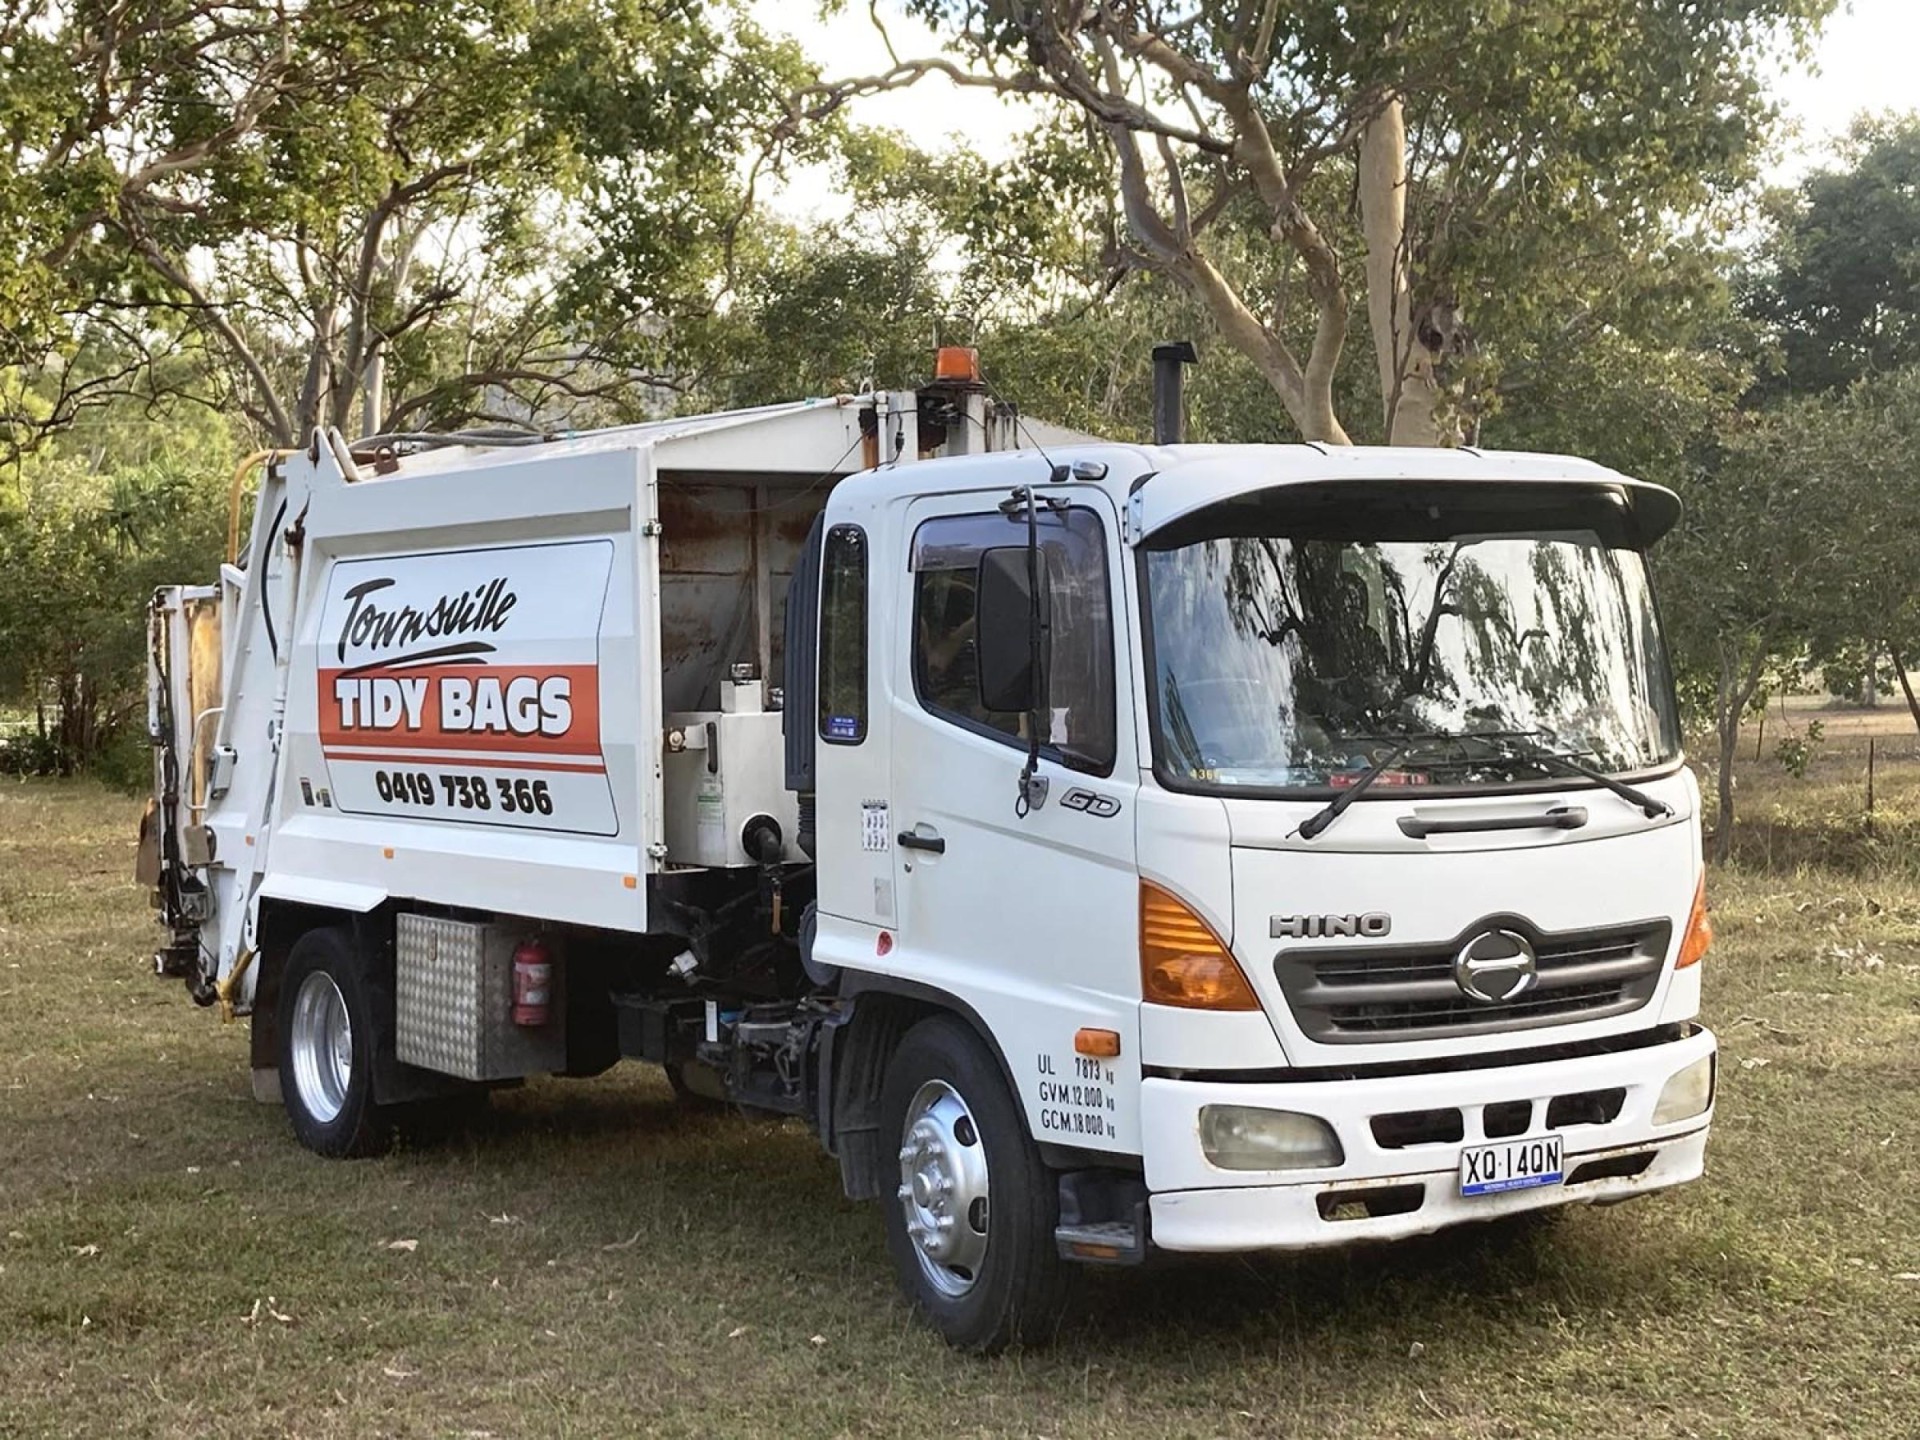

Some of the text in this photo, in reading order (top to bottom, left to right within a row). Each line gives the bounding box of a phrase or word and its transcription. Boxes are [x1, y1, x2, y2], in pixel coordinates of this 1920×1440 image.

[338, 577, 518, 664] Townsville
[335, 676, 574, 737] TIDY BAGS
[375, 770, 435, 806] 0419
[440, 774, 492, 811] 738
[496, 778, 554, 815] 366
[1059, 786, 1122, 818] GD
[1269, 911, 1392, 940] HINO
[1038, 1054, 1056, 1075] UL
[1075, 1057, 1100, 1080] 7873
